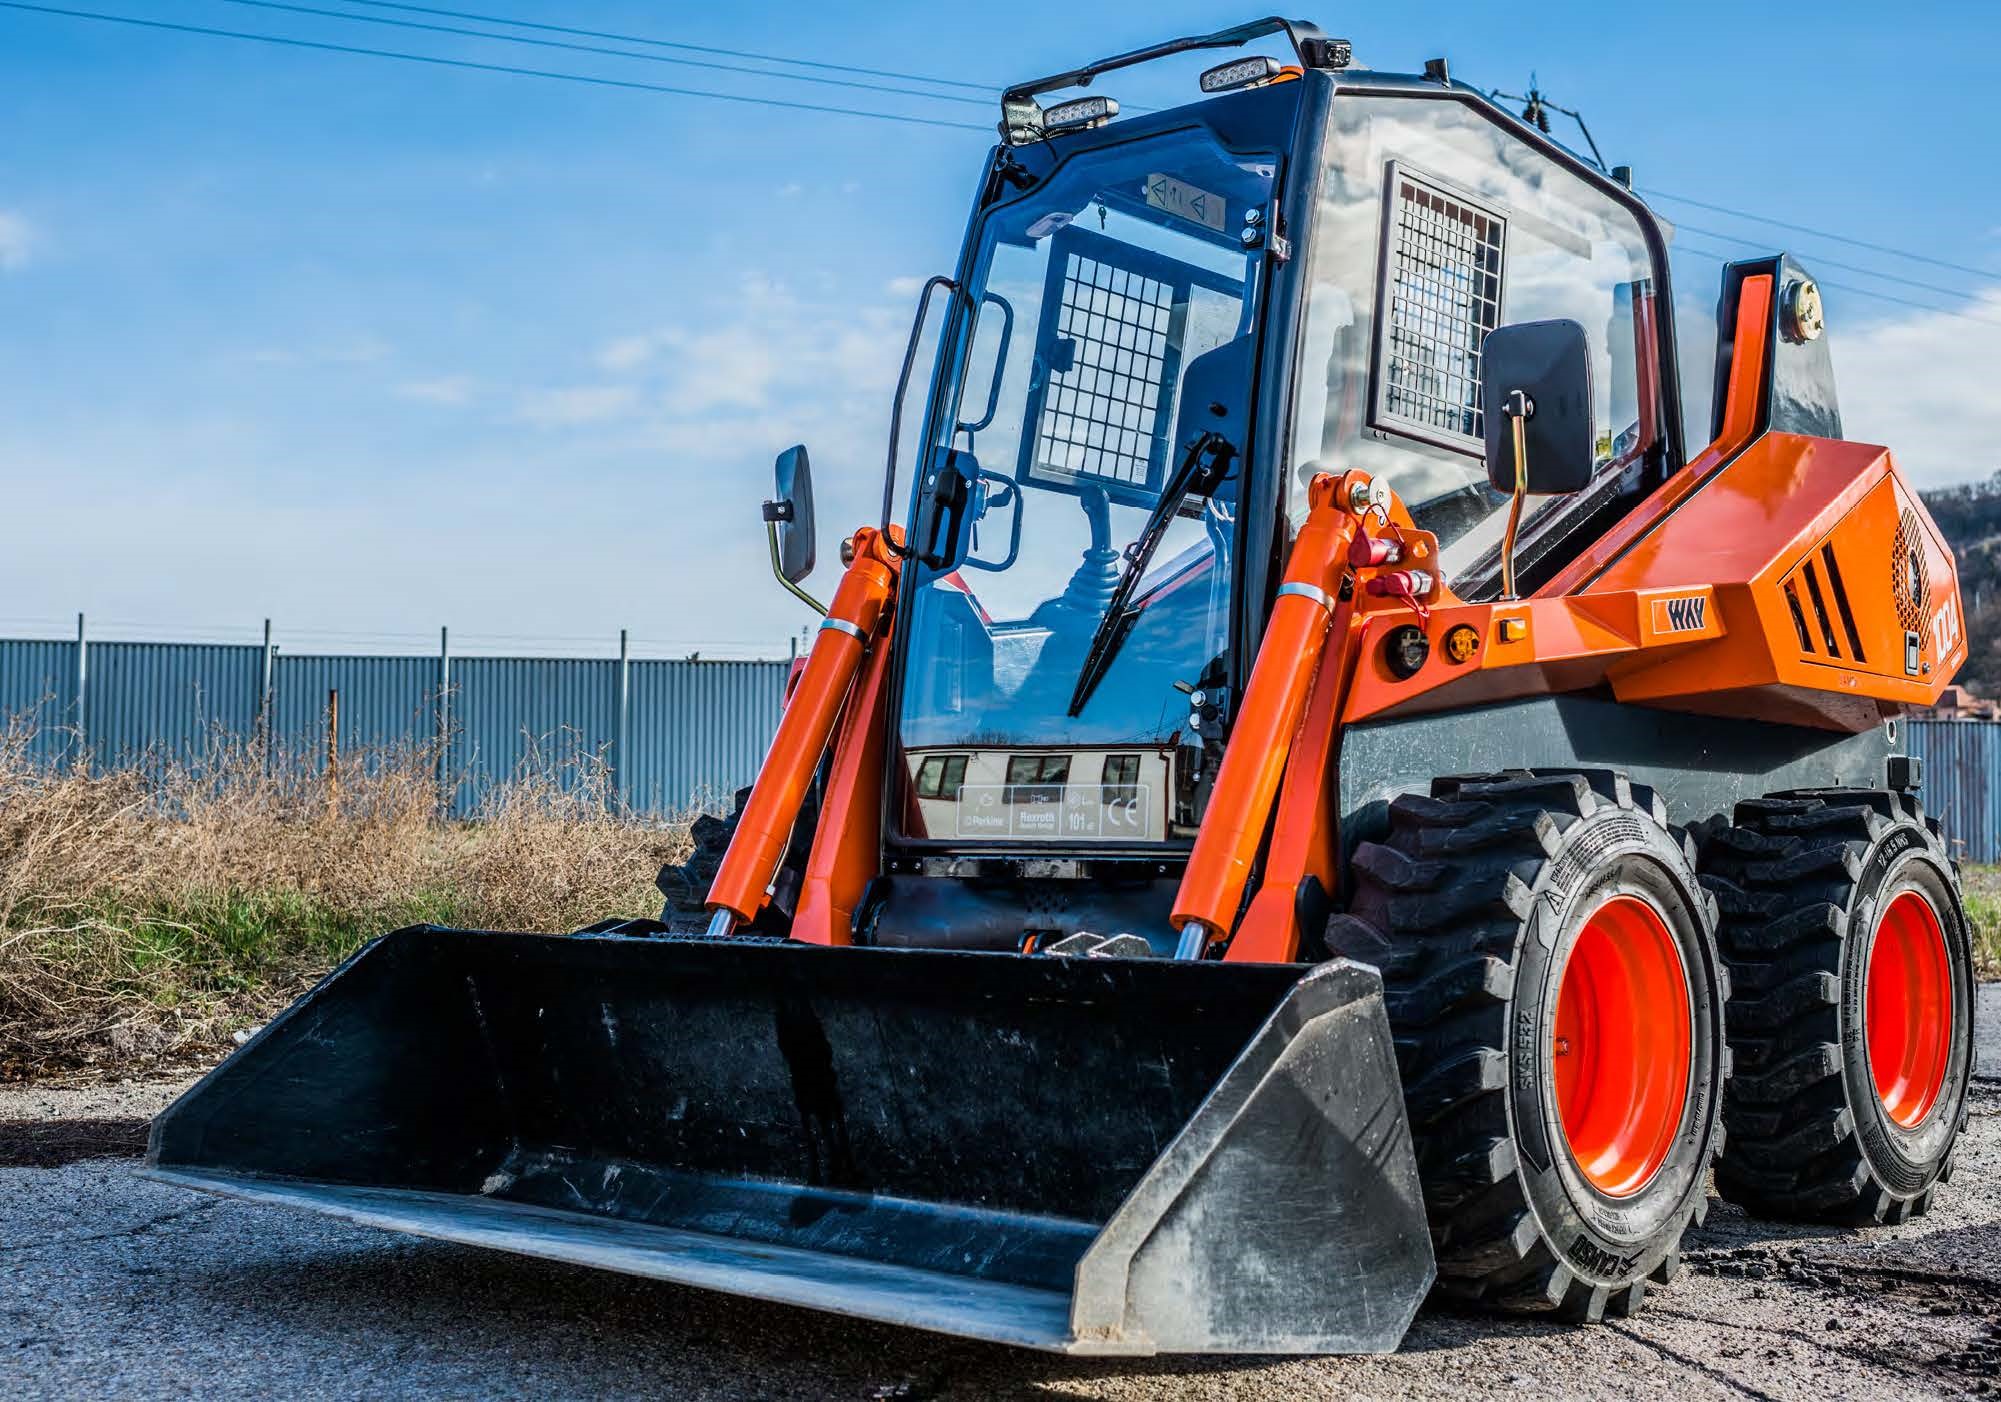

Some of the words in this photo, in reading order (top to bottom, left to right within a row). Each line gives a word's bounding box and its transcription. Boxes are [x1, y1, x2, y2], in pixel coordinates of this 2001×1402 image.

[1668, 597, 1705, 631] WAY
[972, 815, 1003, 827] Perkins
[1108, 797, 1139, 827] CE
[1519, 1009, 1536, 1050] 532
[1566, 1233, 1623, 1276] CAMSO
